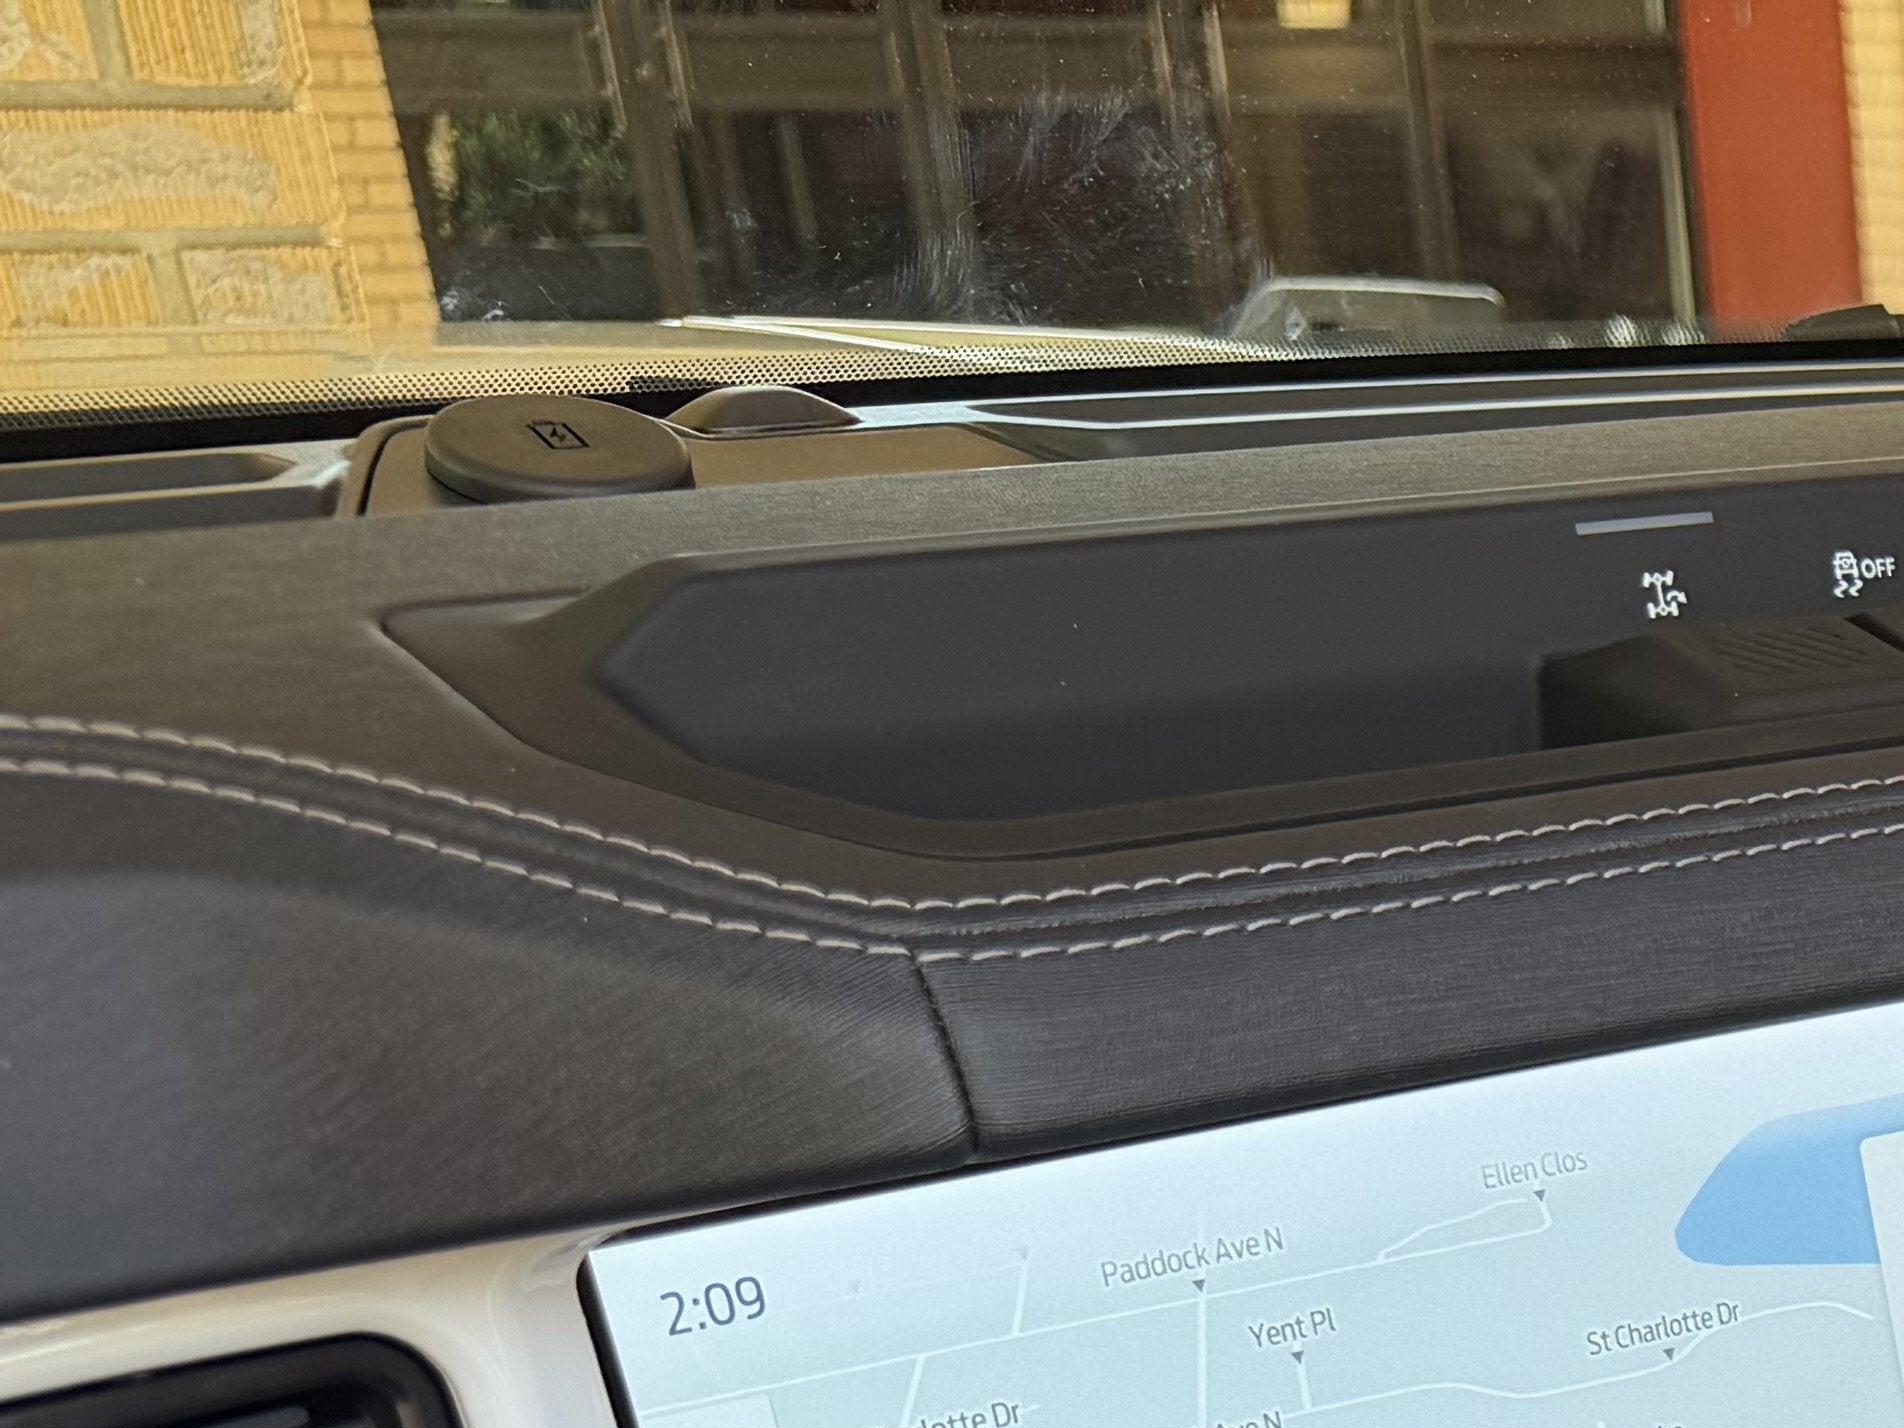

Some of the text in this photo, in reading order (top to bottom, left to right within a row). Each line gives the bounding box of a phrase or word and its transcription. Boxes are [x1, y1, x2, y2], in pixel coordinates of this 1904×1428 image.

[1861, 557, 1896, 578] OFF
[1482, 1151, 1588, 1190] Ellen Clos
[1101, 1227, 1284, 1288] Paddock Ave N
[660, 1277, 766, 1335] 2:09
[1248, 1307, 1336, 1350] Yent Pl
[1587, 1300, 1740, 1356] St Charlotte Dr
